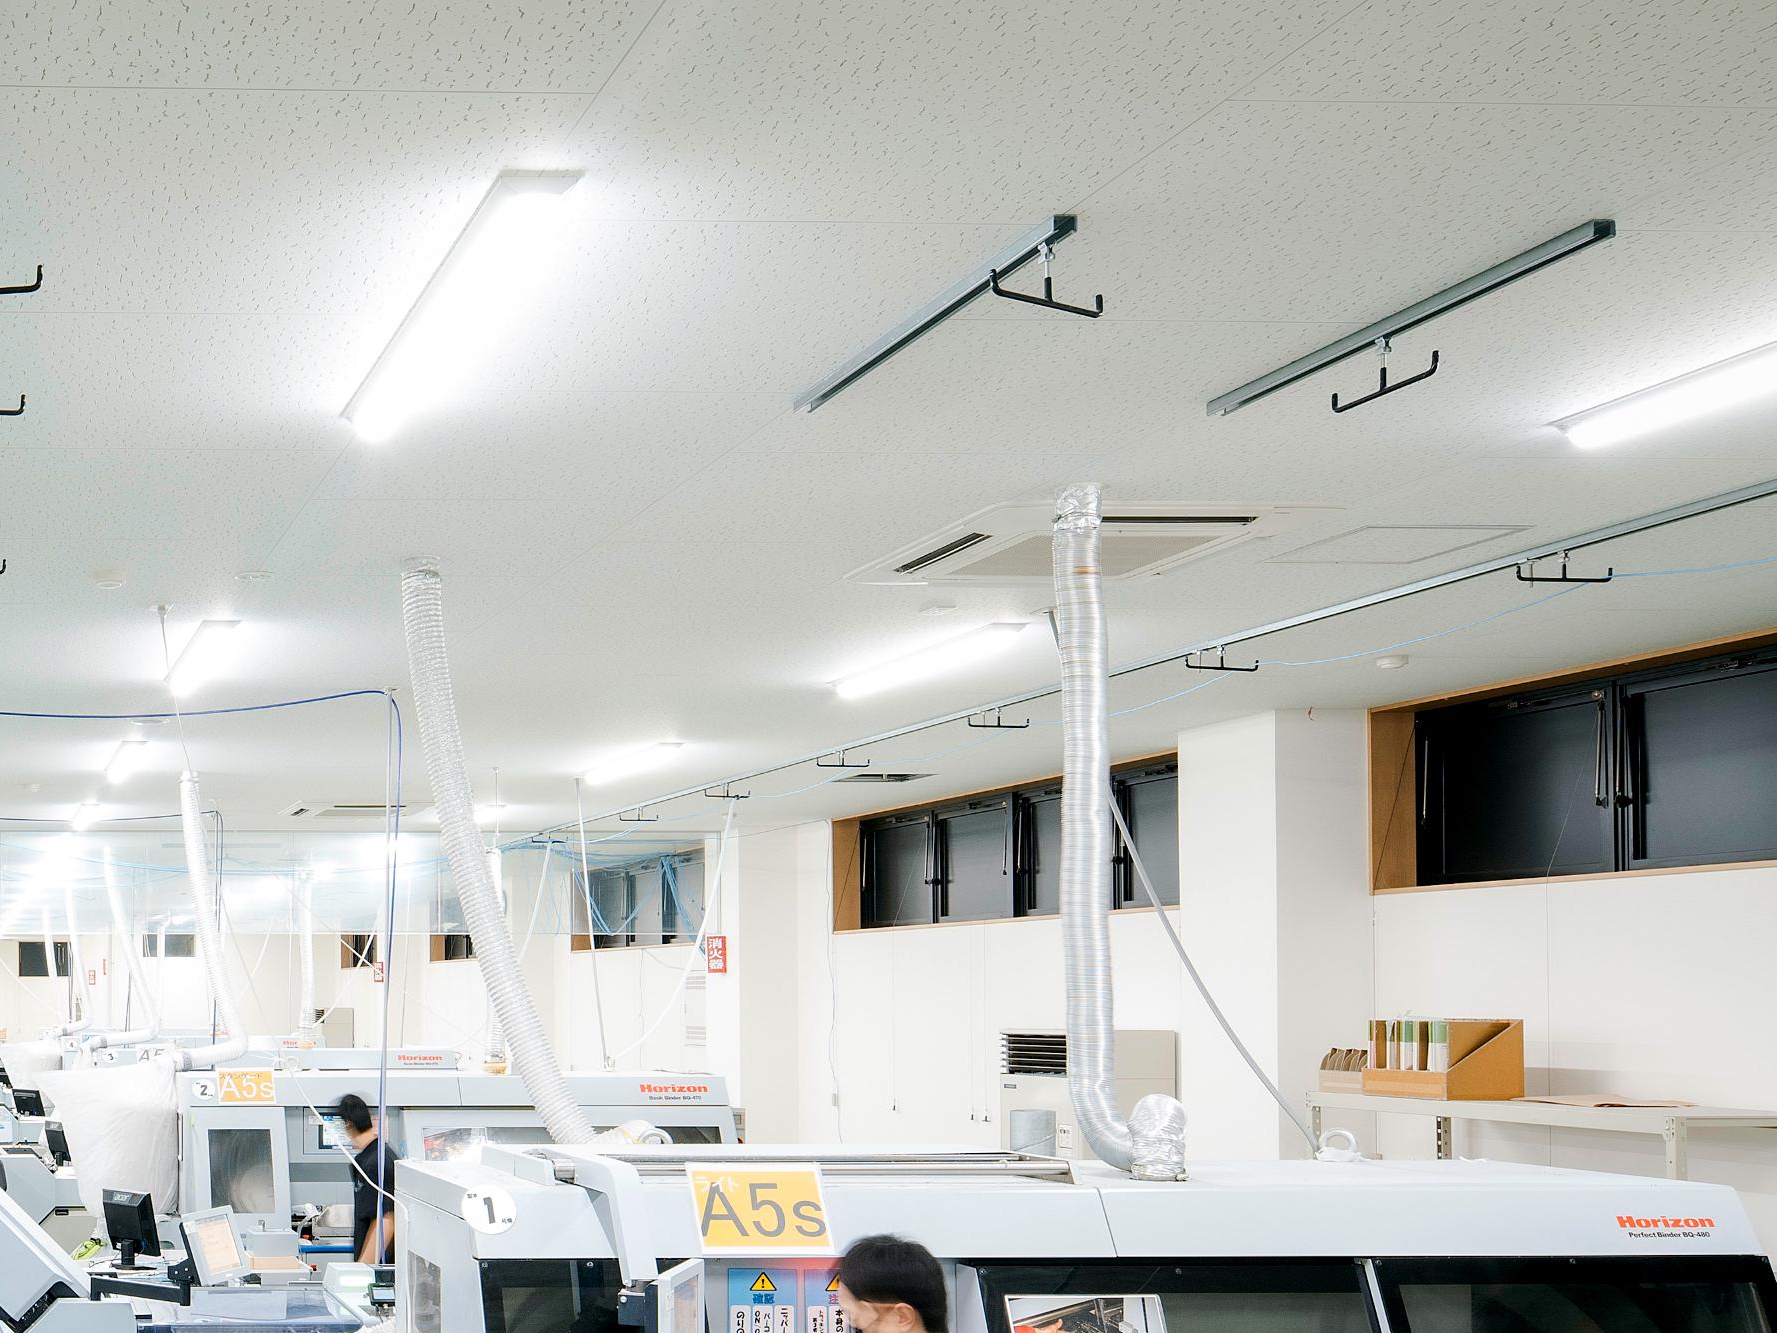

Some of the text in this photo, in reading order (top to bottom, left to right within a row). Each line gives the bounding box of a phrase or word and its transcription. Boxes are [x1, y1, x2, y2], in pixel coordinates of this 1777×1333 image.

[708, 938, 724, 970] 消火器
[200, 1085, 208, 1096] 2
[220, 1074, 274, 1098] A5s
[639, 1084, 709, 1093] Horizon
[694, 1175, 740, 1193] ライト
[483, 1196, 496, 1224] 1
[700, 1182, 827, 1238] A5s
[1616, 1215, 1715, 1228] Horizon
[752, 1293, 775, 1305] 確認
